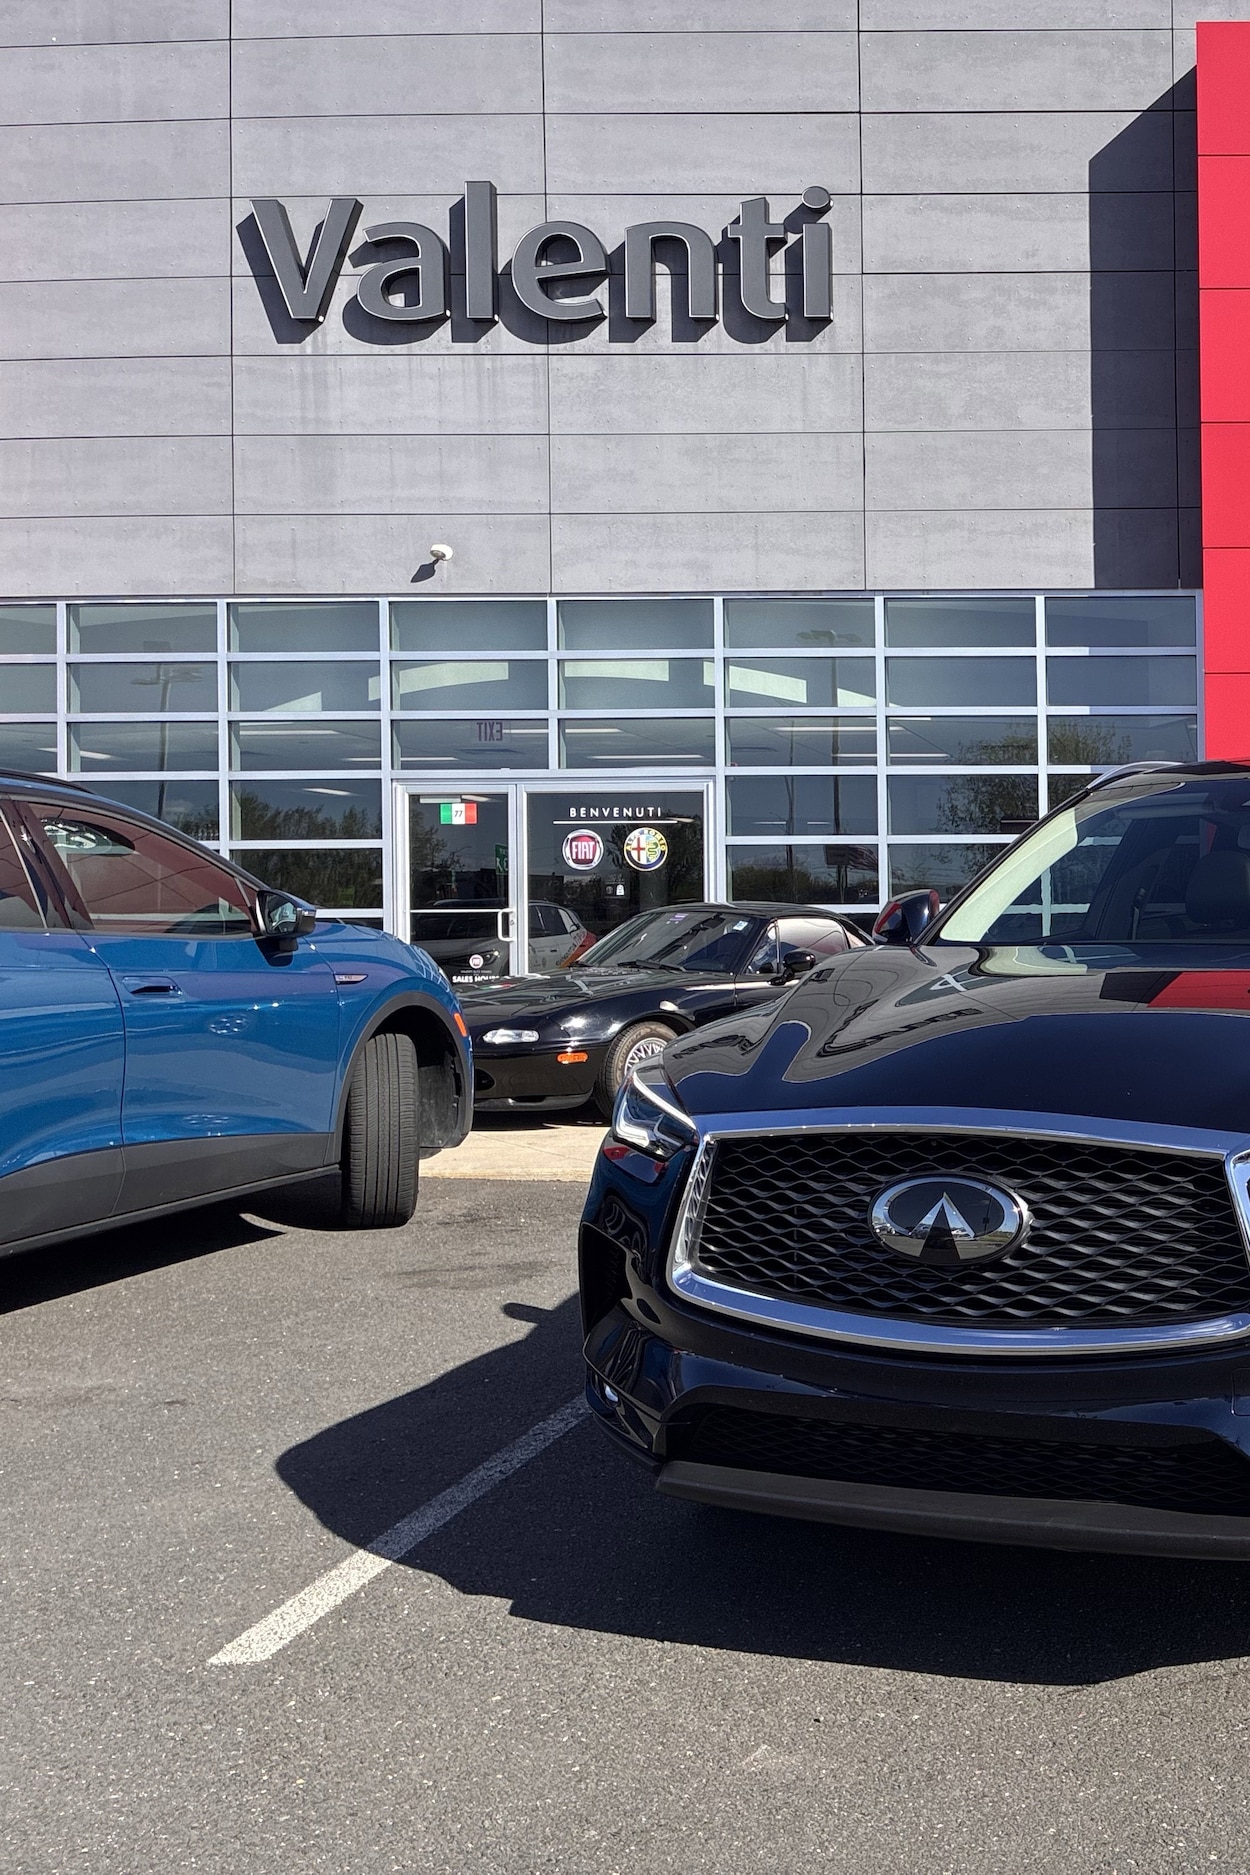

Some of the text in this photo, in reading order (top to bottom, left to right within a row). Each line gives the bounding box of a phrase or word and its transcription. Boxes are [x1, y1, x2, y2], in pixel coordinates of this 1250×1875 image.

[248, 181, 833, 323] Valenti
[569, 806, 662, 818] BENVENUTI
[571, 841, 595, 860] FIAT
[452, 975, 473, 983] SALES
